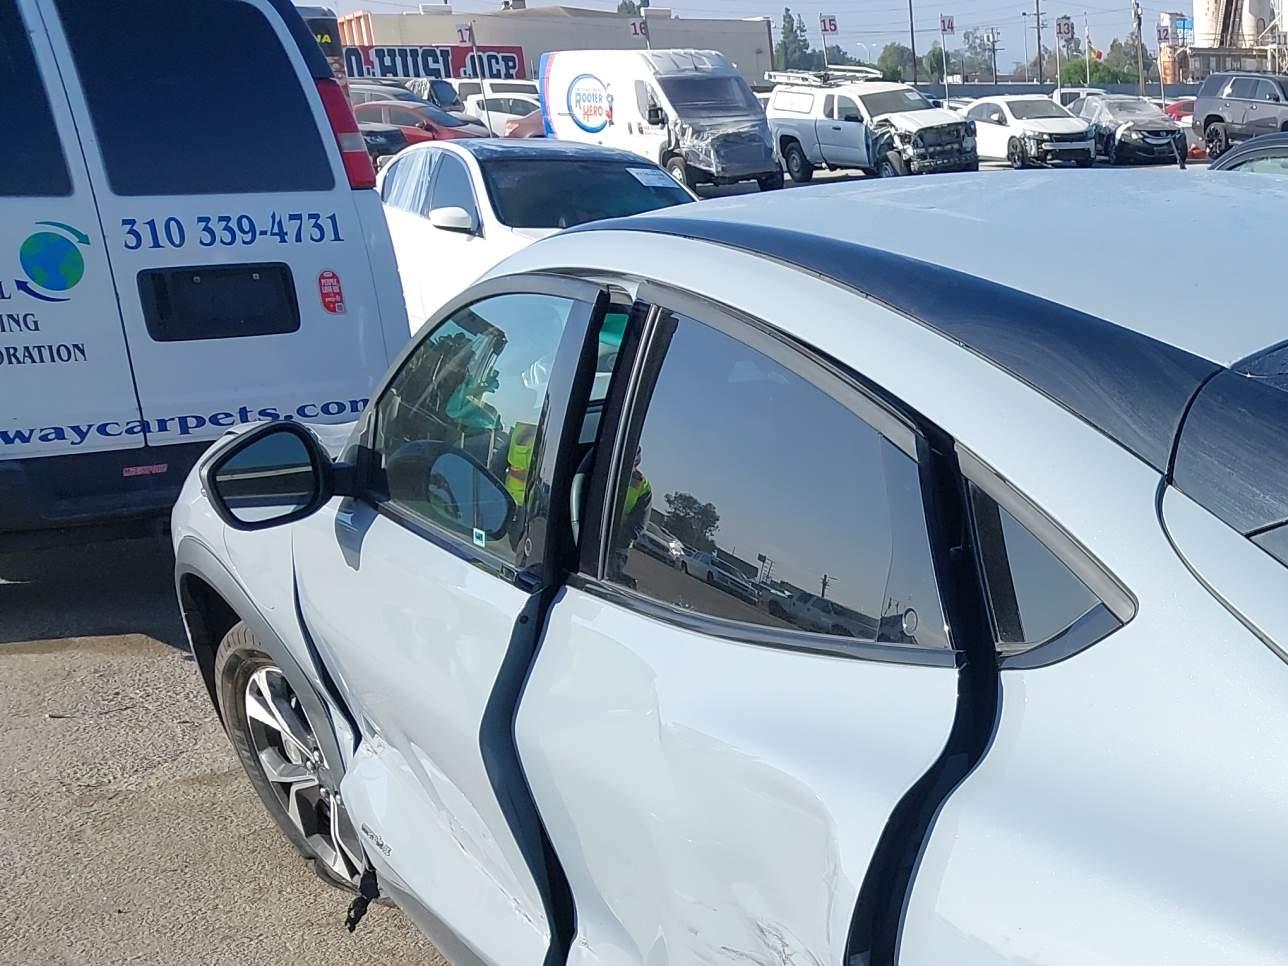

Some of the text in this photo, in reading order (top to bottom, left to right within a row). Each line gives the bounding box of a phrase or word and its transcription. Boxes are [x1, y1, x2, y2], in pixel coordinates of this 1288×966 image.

[631, 22, 648, 36] 16
[820, 18, 837, 32] 15
[941, 19, 954, 32] 14
[1056, 22, 1070, 34] 13
[457, 27, 472, 43] 17
[1157, 28, 1169, 40] 12
[575, 92, 603, 110] ROOTER
[582, 104, 604, 122] HERO
[121, 210, 345, 250] 310 339-4731
